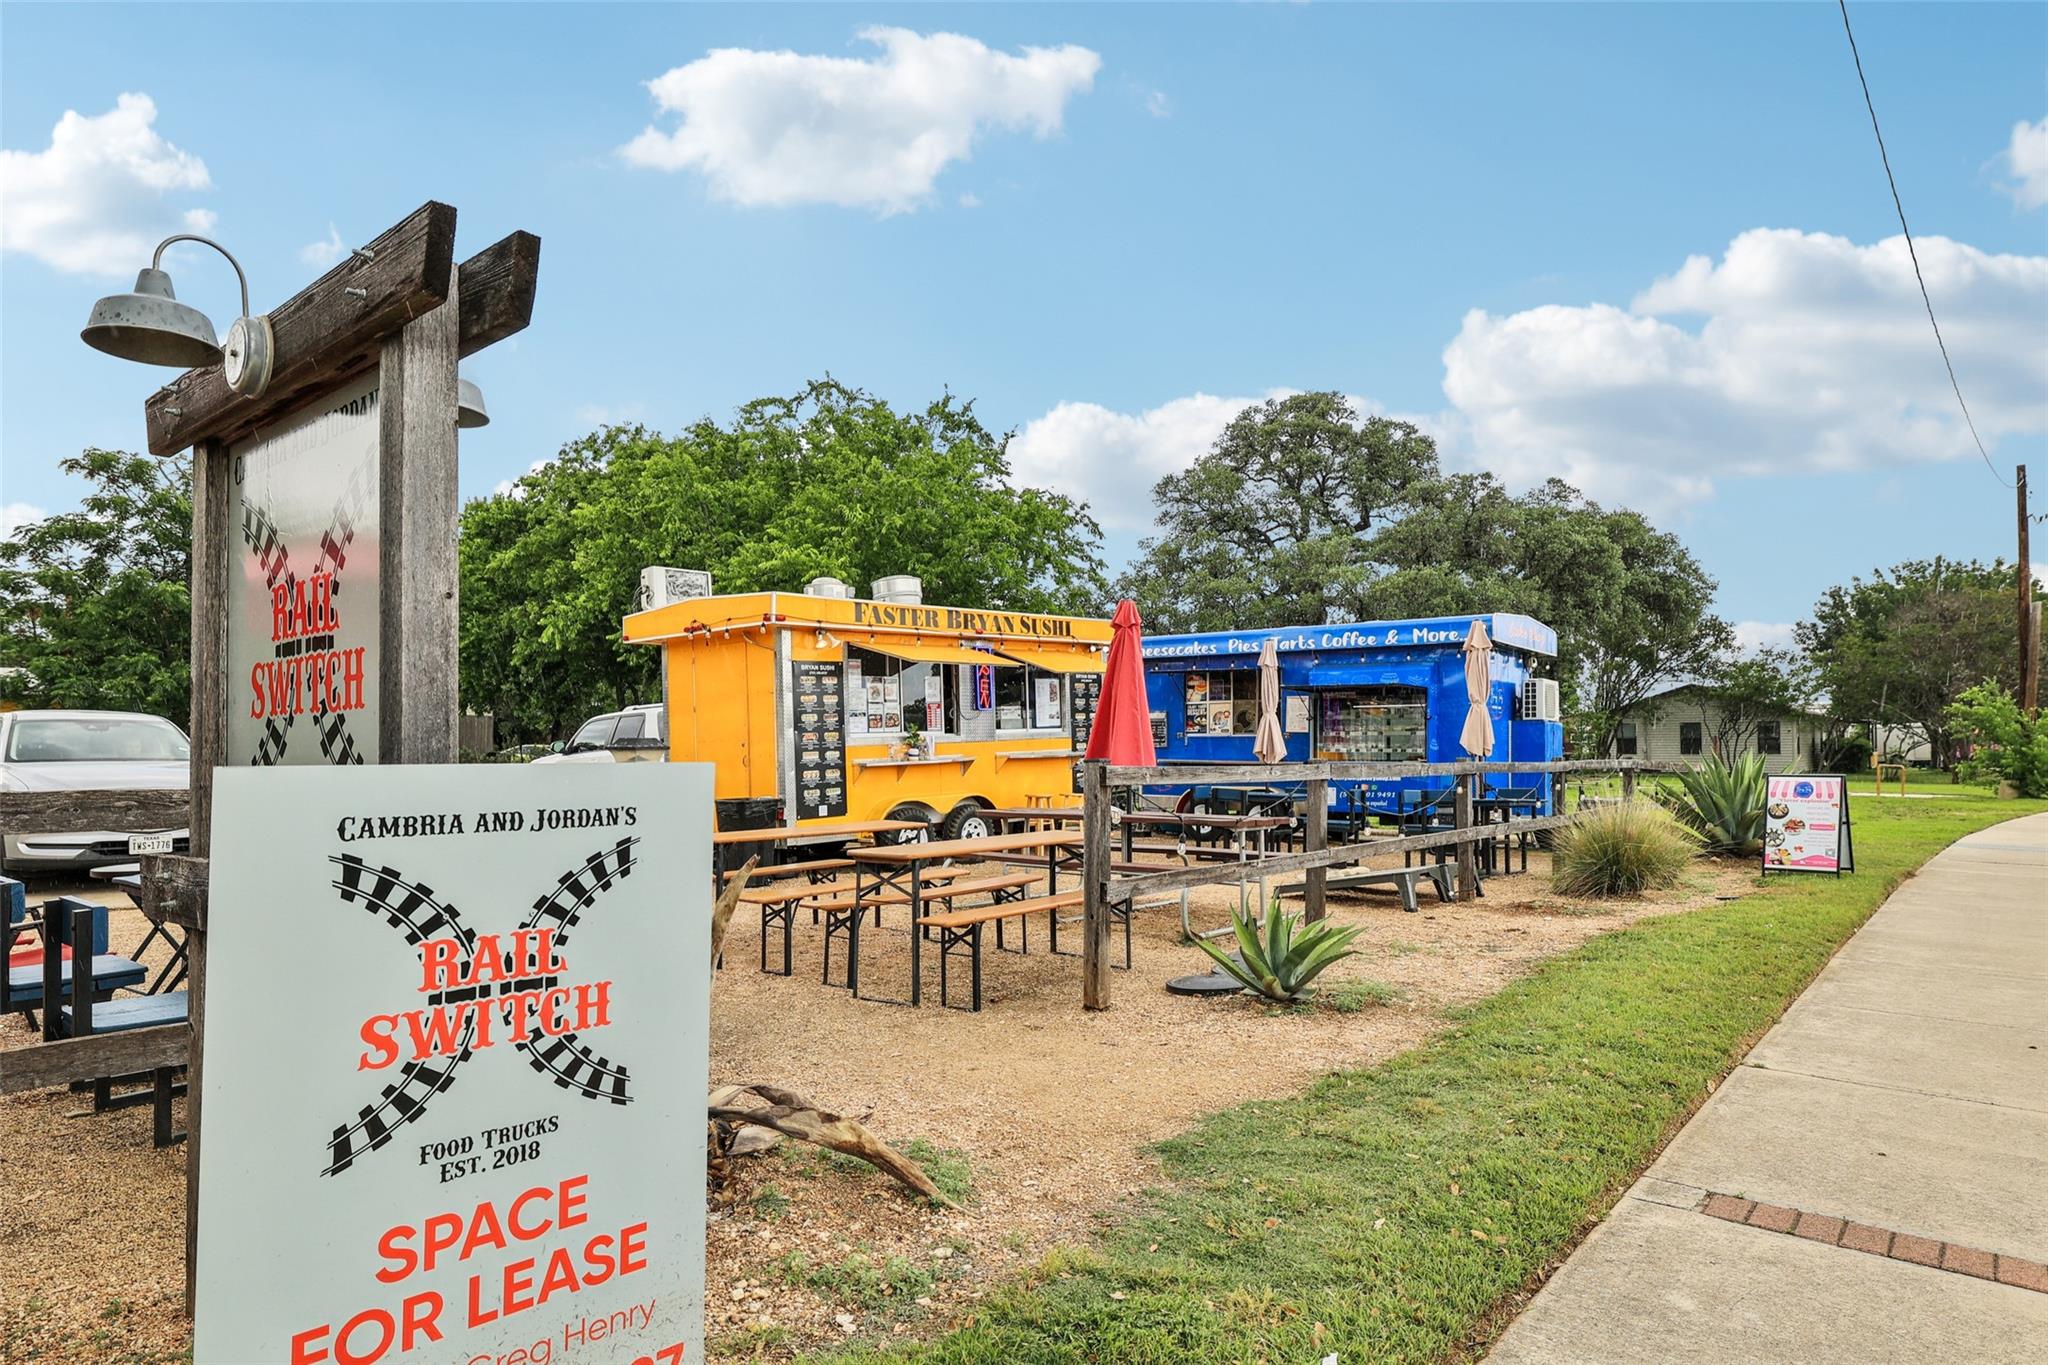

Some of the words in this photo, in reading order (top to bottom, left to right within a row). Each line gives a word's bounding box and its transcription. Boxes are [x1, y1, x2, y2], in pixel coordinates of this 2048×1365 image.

[271, 570, 339, 642] RAIL
[854, 602, 939, 628] FASTER
[947, 609, 1015, 633] BRYAN
[1020, 616, 1072, 636] SUSHI
[1142, 642, 1217, 657] eesecakes
[1228, 638, 1259, 652] Pies
[1271, 636, 1315, 650] Tarts
[1321, 631, 1377, 648] Coffee
[1385, 629, 1398, 645] &
[250, 646, 367, 720] SWITCH
[337, 814, 464, 842] CAMBRIA
[473, 811, 525, 833] AND
[530, 806, 637, 832] JORDAN'S
[417, 928, 568, 993] RAIL
[356, 980, 614, 1072] SWITCH
[419, 1136, 474, 1166] FOOD
[481, 1115, 559, 1150] TRUCKS
[440, 1156, 486, 1184] EST.
[492, 1140, 541, 1170] 2018
[374, 1174, 589, 1284] SPACE
[290, 1291, 444, 1365] FOR
[468, 1222, 648, 1329] LEASE
[565, 1299, 656, 1351] Henry
